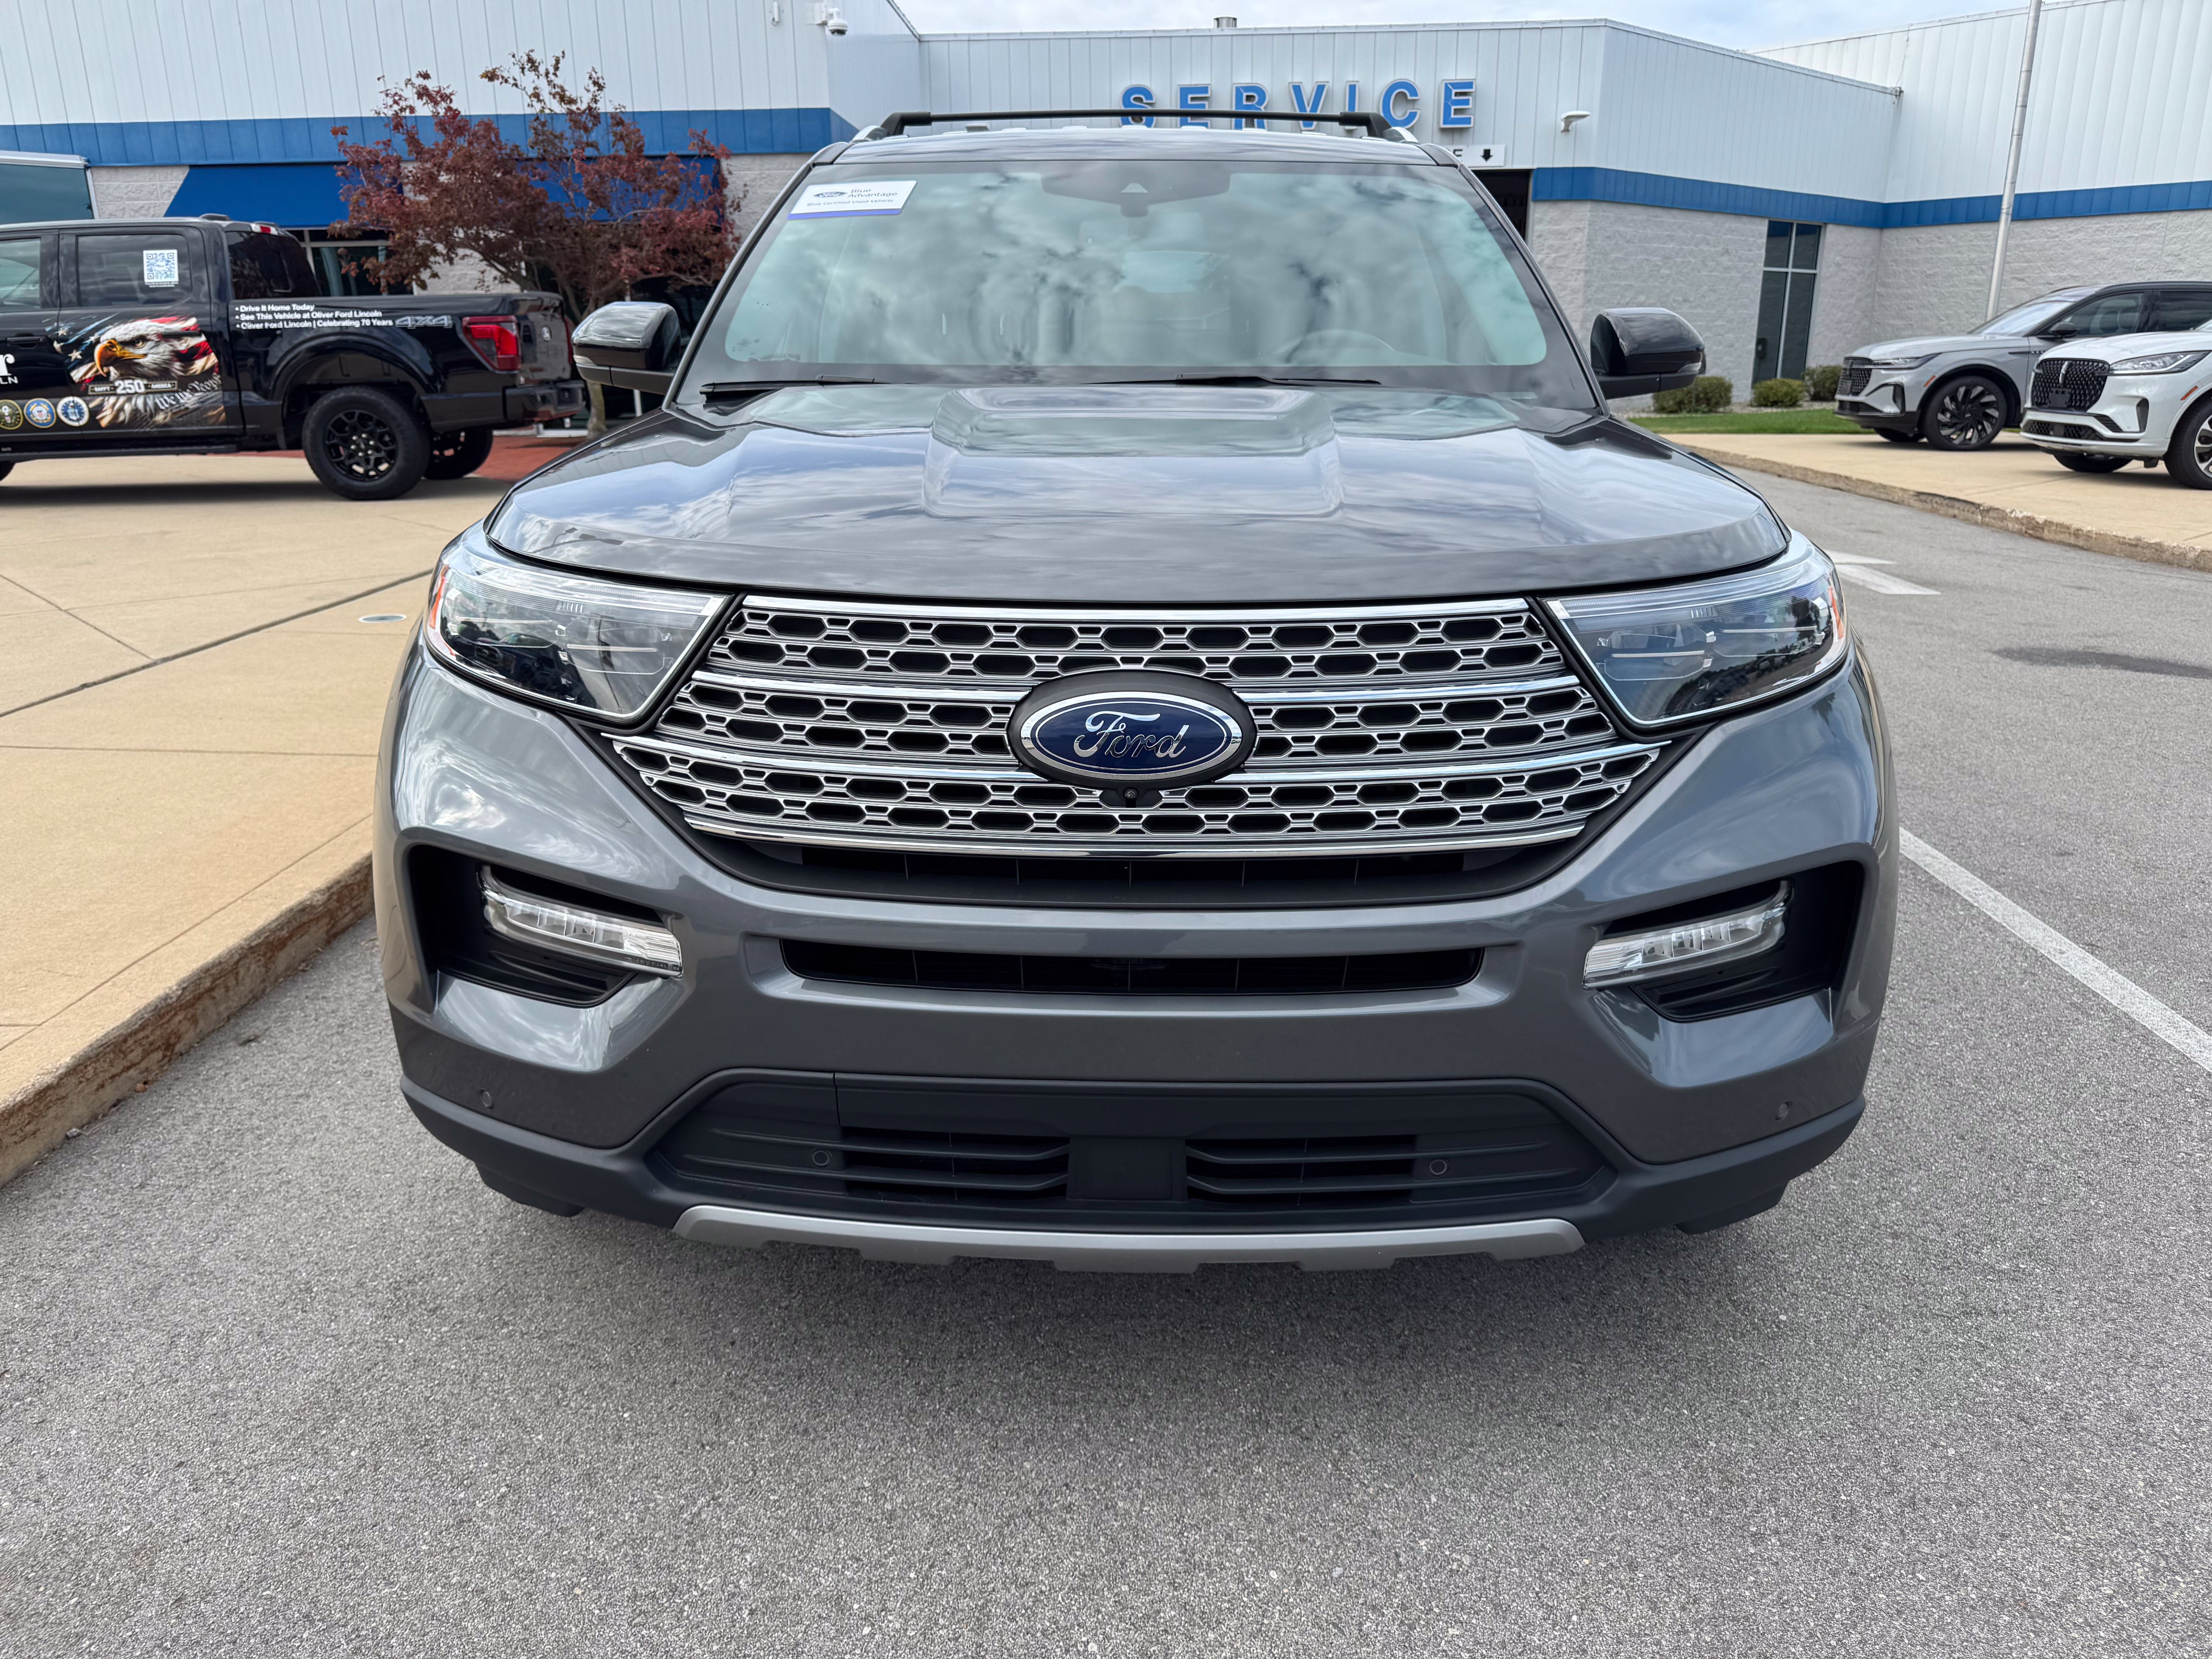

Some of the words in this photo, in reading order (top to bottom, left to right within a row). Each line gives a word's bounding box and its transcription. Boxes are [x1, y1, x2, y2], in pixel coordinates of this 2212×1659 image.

[1120, 79, 1475, 131] SERVICE
[291, 304, 315, 312] Today
[317, 318, 360, 327] Celebrating
[371, 318, 393, 326] Years
[114, 380, 146, 394] 250
[155, 395, 176, 409] We
[175, 388, 192, 403] the
[1073, 711, 1190, 758] Ford
